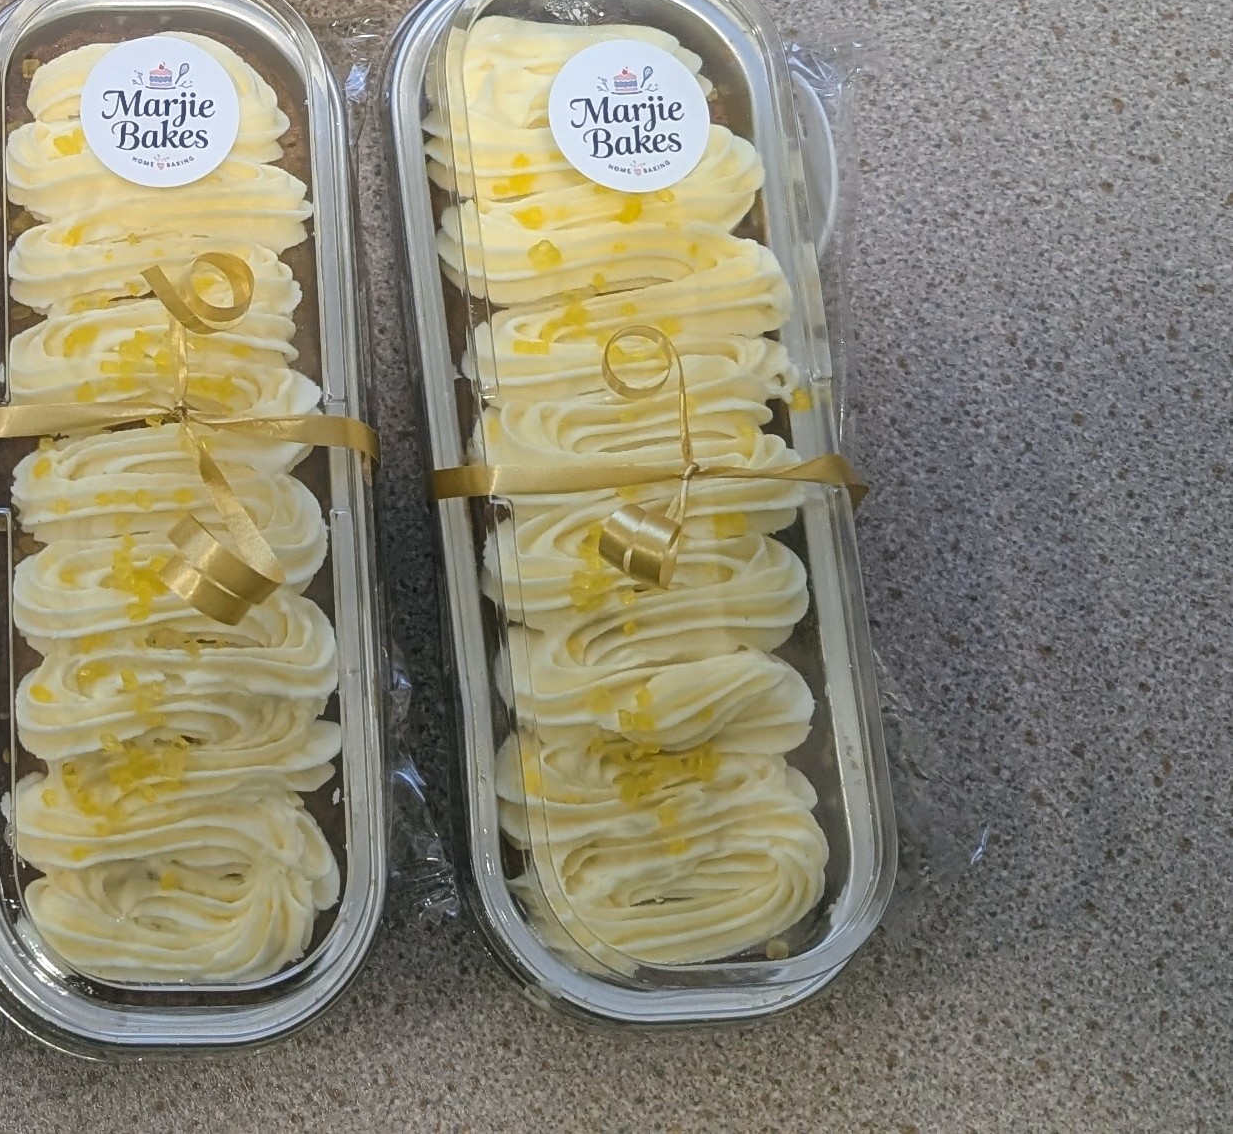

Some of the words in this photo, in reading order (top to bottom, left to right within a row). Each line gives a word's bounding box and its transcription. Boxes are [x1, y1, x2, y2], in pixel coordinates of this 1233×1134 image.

[101, 90, 215, 127] Marjie
[570, 96, 684, 132] Marjie
[111, 120, 209, 150] Bakes
[583, 125, 682, 158] Bakes
[132, 156, 154, 167] HOME
[167, 156, 195, 167] BAKING
[608, 164, 632, 174] HOME
[643, 160, 670, 174] BAKING
